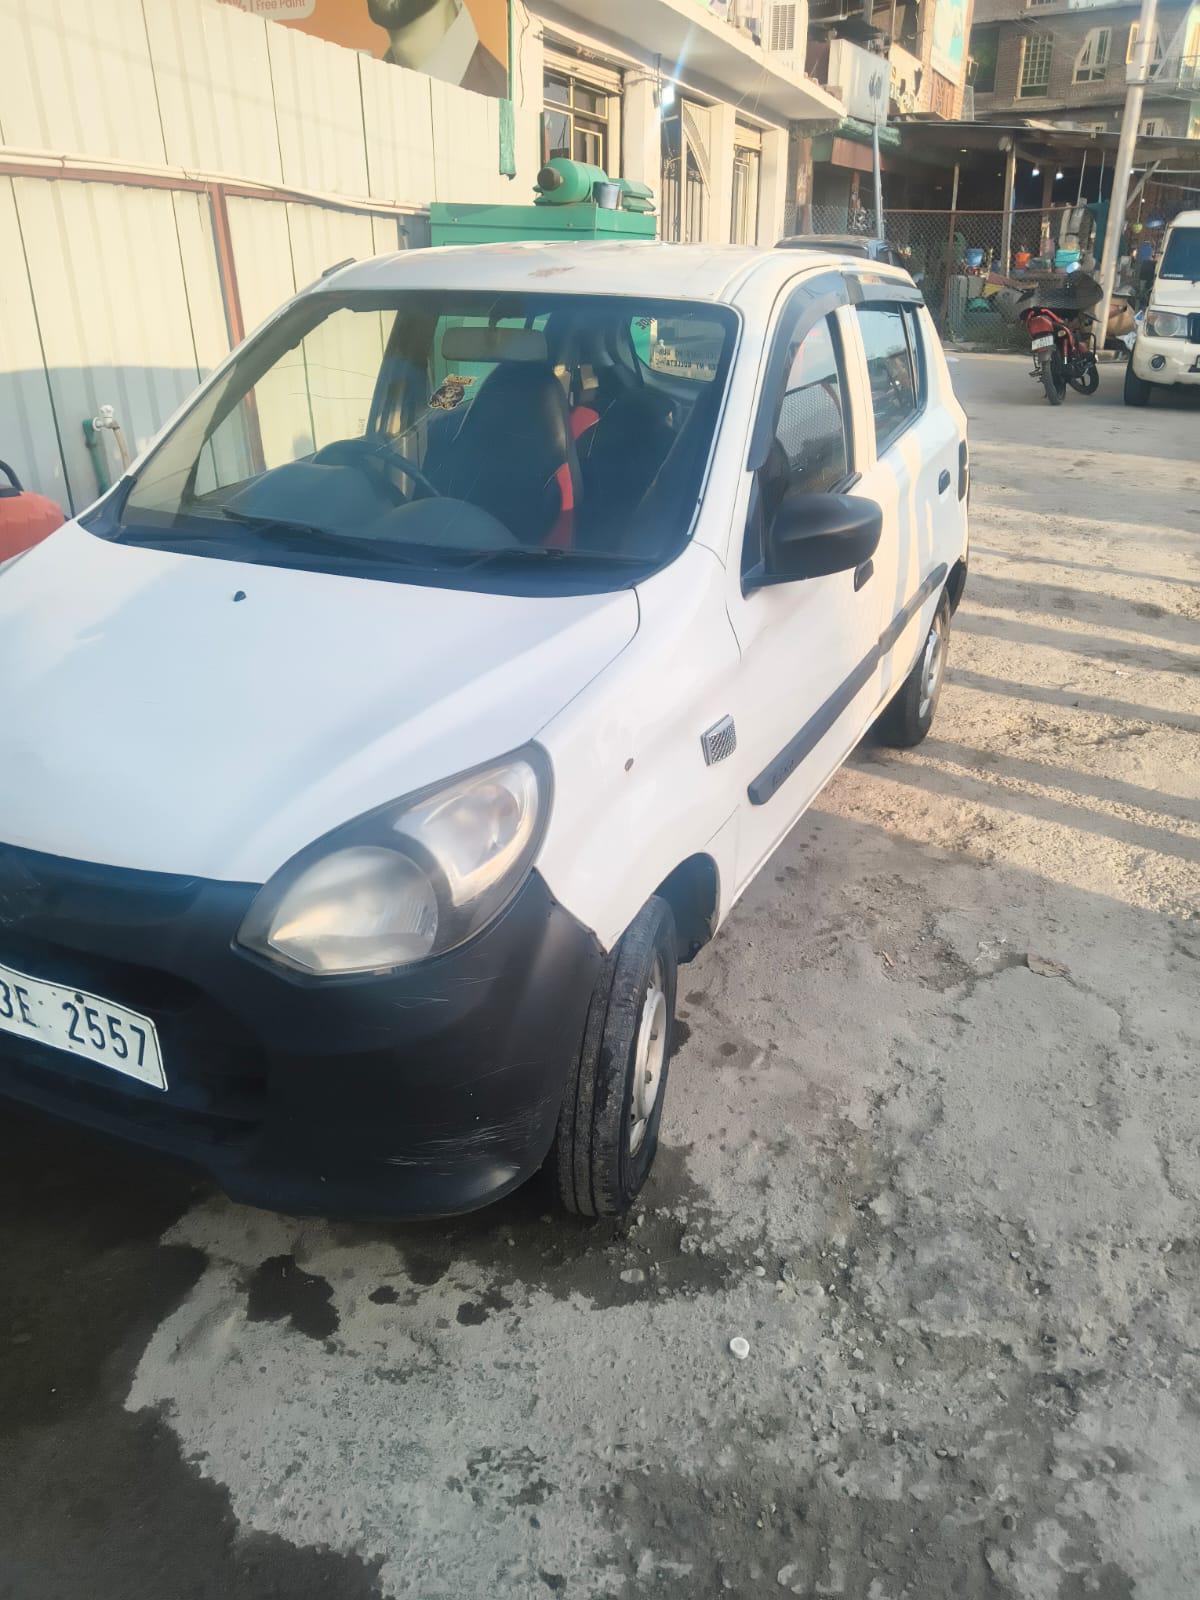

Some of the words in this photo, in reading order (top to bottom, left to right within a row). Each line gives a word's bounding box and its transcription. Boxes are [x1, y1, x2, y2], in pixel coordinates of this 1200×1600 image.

[256, 0, 277, 11] Free
[279, 0, 305, 9] Paint
[62, 1001, 146, 1067] 2557
